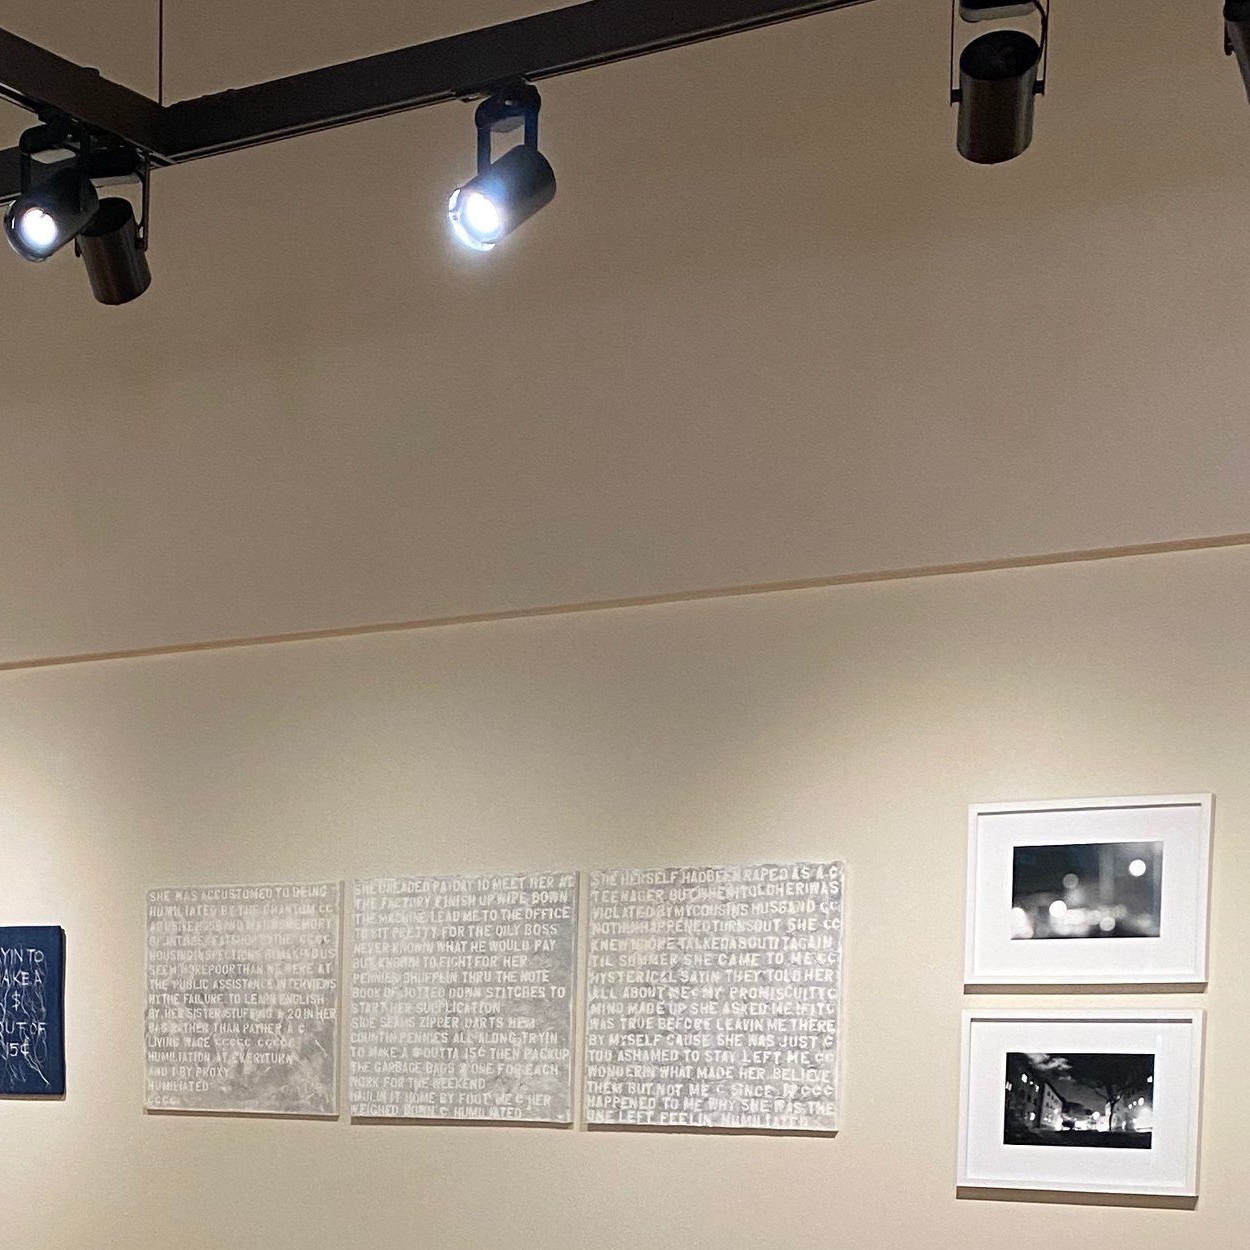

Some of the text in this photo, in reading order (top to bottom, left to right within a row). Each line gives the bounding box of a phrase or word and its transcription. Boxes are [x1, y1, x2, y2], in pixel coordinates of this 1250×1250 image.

[482, 909, 498, 921] TO
[526, 906, 570, 920] OFFICE
[442, 926, 464, 938] FOR
[524, 924, 557, 936] BOSS
[788, 918, 816, 931] SHE
[534, 939, 556, 951] PAY
[26, 949, 44, 962] TO
[718, 952, 760, 966] CAME
[767, 952, 784, 966] TO
[34, 970, 42, 984] A
[804, 969, 834, 982] HER
[230, 994, 240, 1004] TO
[550, 986, 566, 998] TO
[692, 1003, 719, 1016] SHE
[792, 1019, 835, 1033] THERE
[588, 1035, 604, 1048] BY
[717, 1035, 743, 1048] SHE
[780, 1035, 818, 1049] JUST
[617, 1050, 680, 1063] ASHAMED
[684, 1050, 701, 1063] TO
[743, 1050, 782, 1064] LEFT
[739, 1066, 765, 1080] HER
